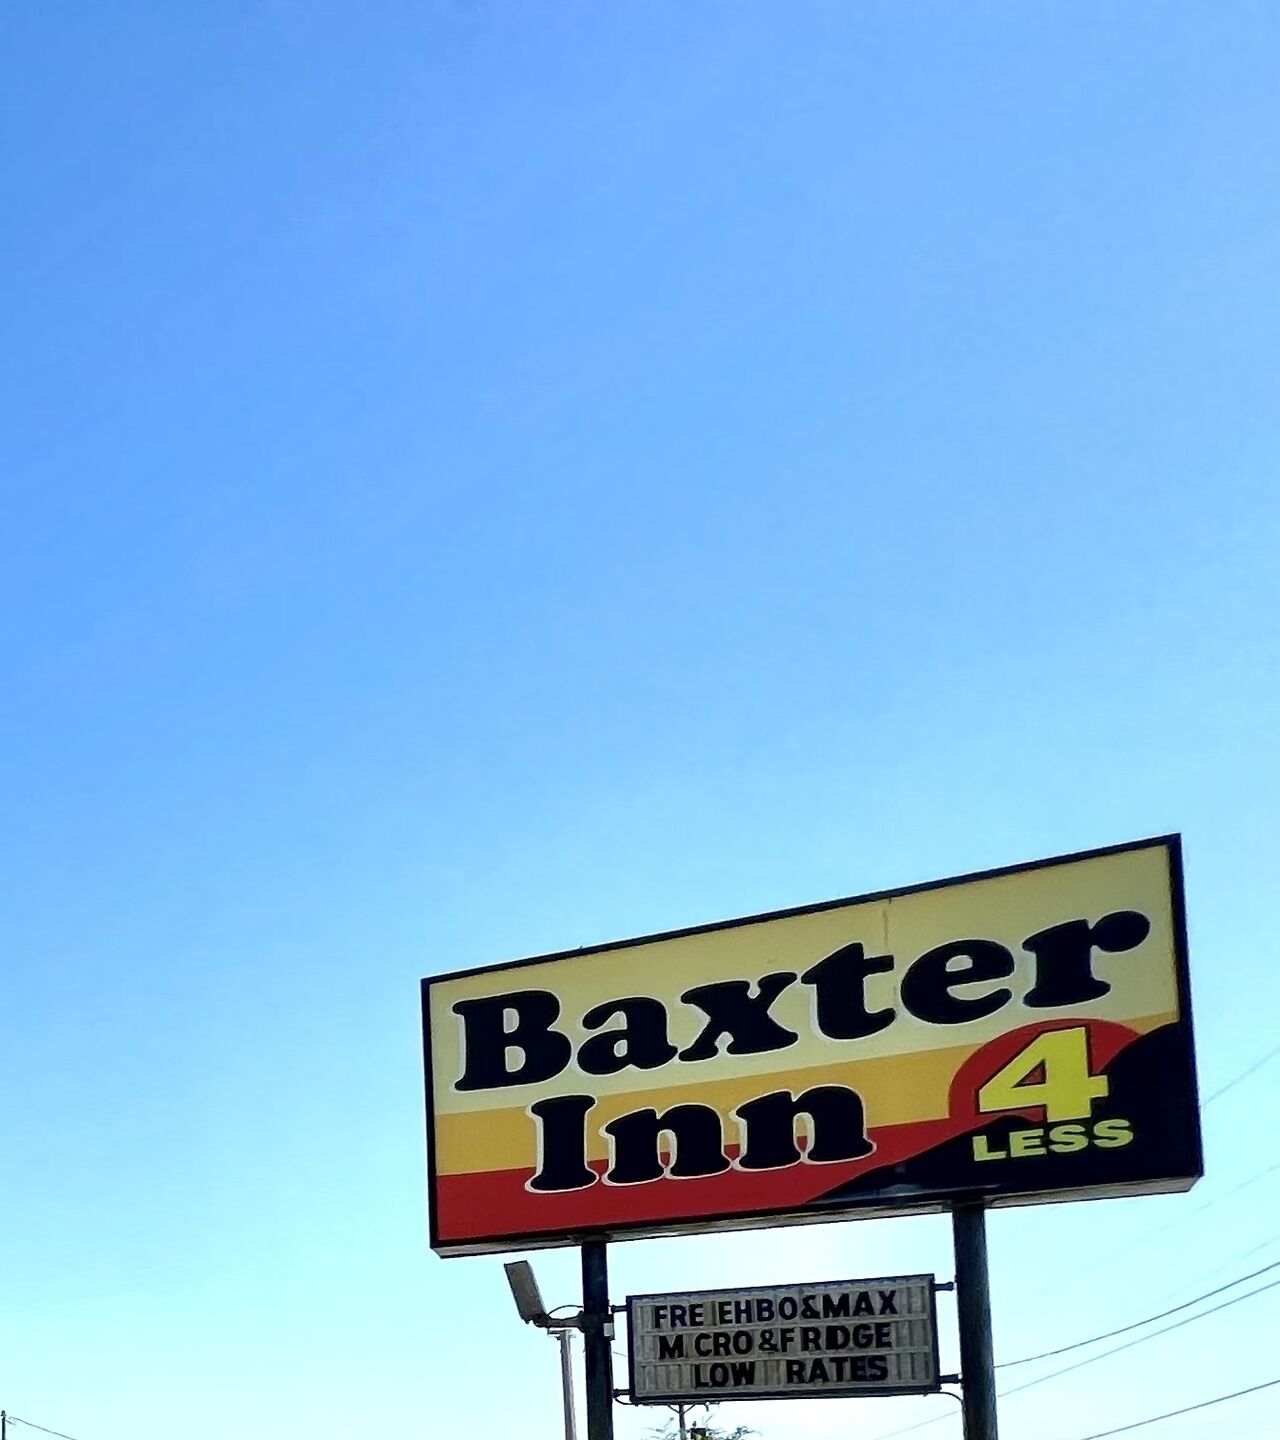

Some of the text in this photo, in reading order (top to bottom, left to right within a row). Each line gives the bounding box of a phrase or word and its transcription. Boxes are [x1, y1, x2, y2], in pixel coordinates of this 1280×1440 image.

[452, 909, 1152, 1091] Baxter
[978, 1027, 1109, 1123] 4
[528, 1084, 876, 1192] Inn
[972, 1118, 1134, 1162] LESS
[694, 1354, 889, 1387] LOW RATES
